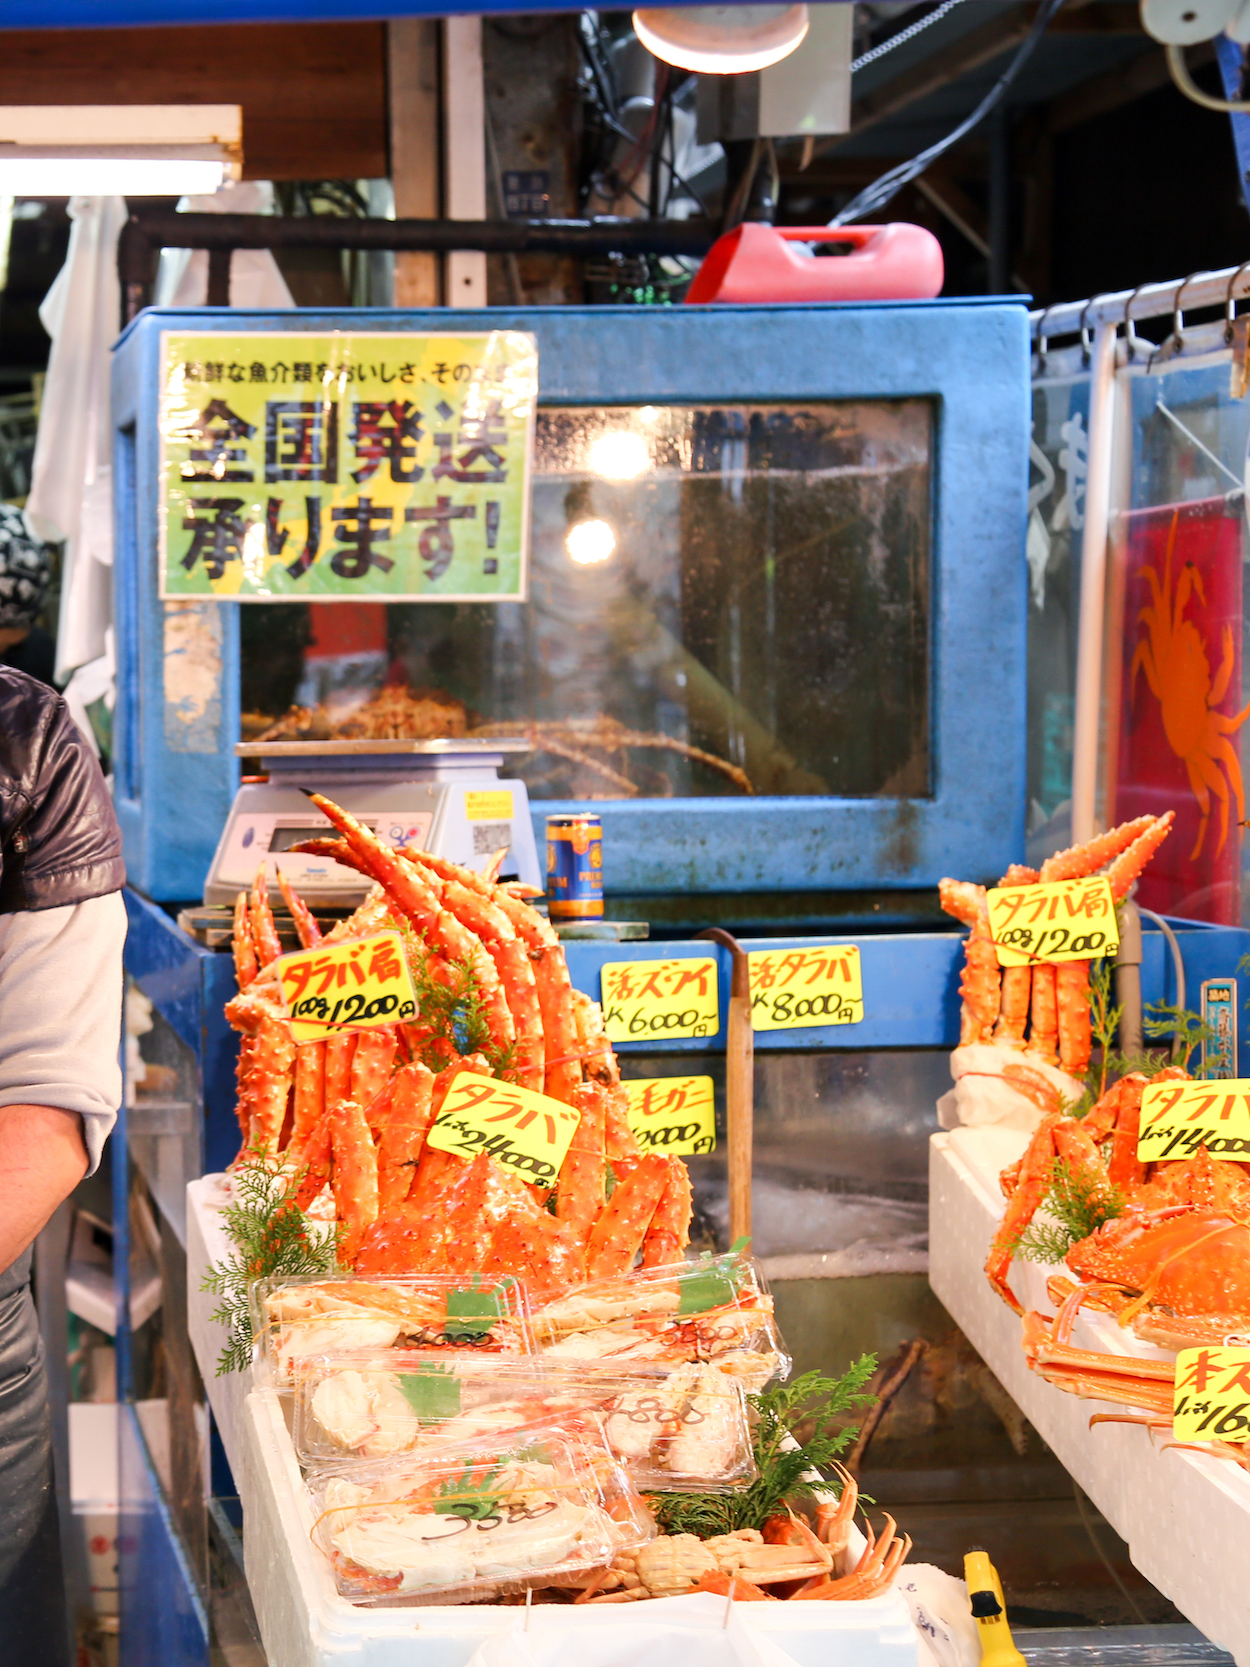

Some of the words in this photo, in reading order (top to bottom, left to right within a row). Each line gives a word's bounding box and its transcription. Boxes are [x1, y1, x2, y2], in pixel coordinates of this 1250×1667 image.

[181, 400, 507, 484] 全国発送
[994, 880, 1109, 930] タラバ肩
[282, 940, 401, 1005] タラバ肩
[607, 961, 713, 1001] 活ズワイ
[291, 996, 330, 1019] 100g
[442, 1083, 579, 1145] タラバ
